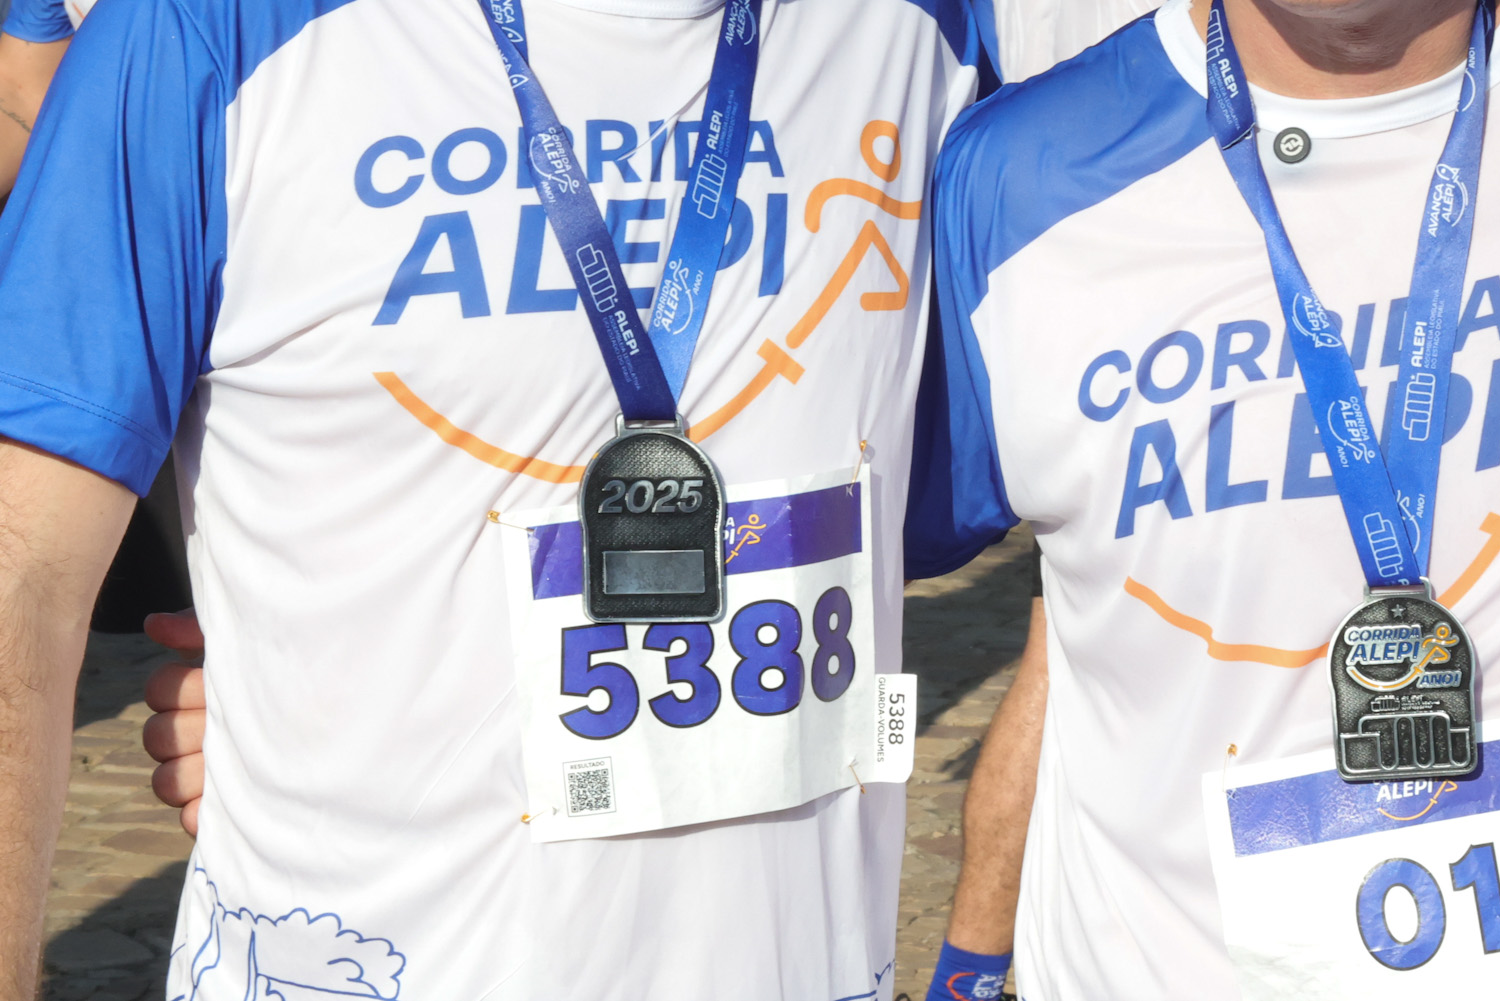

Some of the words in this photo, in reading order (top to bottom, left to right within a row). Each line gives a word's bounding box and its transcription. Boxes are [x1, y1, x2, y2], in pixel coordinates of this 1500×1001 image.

[724, 1, 739, 46] AVANÇA
[1218, 58, 1239, 98] ALEPI
[548, 126, 572, 171] CORRIDA
[706, 110, 723, 150] ALEPI
[537, 133, 566, 174] ALEPI
[1427, 183, 1445, 238] AVANÇA
[1441, 183, 1456, 223] ALEPI
[653, 279, 672, 327] CORRIDA
[661, 281, 682, 332] ALEPI
[1301, 295, 1321, 331] ALEPI
[614, 310, 640, 356] ALEPI
[1410, 321, 1428, 368] ALEPI
[1338, 400, 1362, 443] ALEPI
[1350, 396, 1370, 442] CORRIDA
[598, 479, 704, 514] 2025
[1347, 626, 1421, 643] CORRIDA
[1350, 640, 1421, 662] ALEPI
[559, 585, 857, 741] 5388
[877, 676, 886, 763] GUARDA-VOLUMES
[889, 693, 905, 745] 5388
[570, 760, 606, 770] RESULTADO
[1376, 778, 1433, 803] ALEPI
